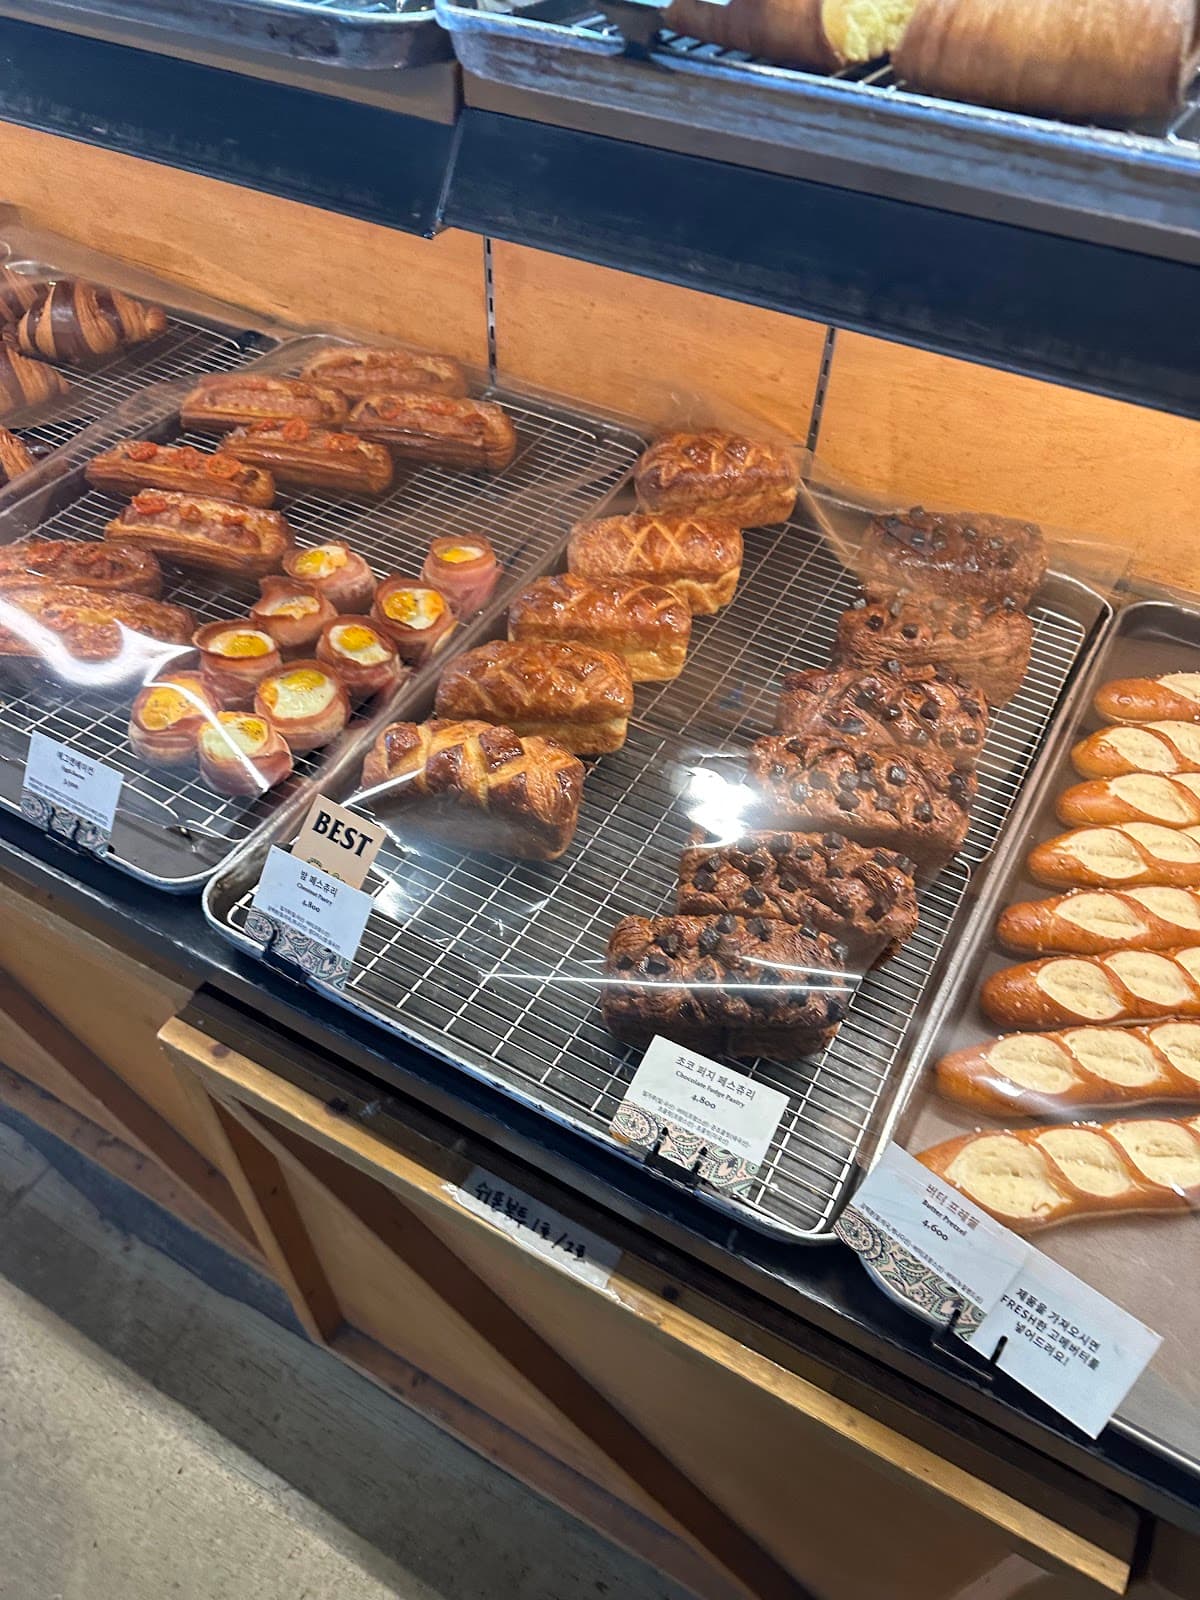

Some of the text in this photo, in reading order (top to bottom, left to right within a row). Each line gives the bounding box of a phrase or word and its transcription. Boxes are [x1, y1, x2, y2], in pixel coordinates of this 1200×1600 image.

[312, 811, 374, 856] BEST
[299, 870, 338, 897] 밤 페스츄리
[675, 1056, 756, 1100] 초코 퍼지 페스츄리
[676, 1071, 745, 1108] Chocolate Fudge Pastry
[691, 1094, 716, 1110] 4,800
[926, 1184, 948, 1205] 버터
[922, 1200, 967, 1236] Butter Pretzel
[922, 1220, 948, 1241] 4,600
[1000, 1295, 1100, 1372] FRESH한 고메버터를
[1015, 1287, 1102, 1353] 제품을 가져오시면
[1015, 1321, 1070, 1367] 넣어드려요!
